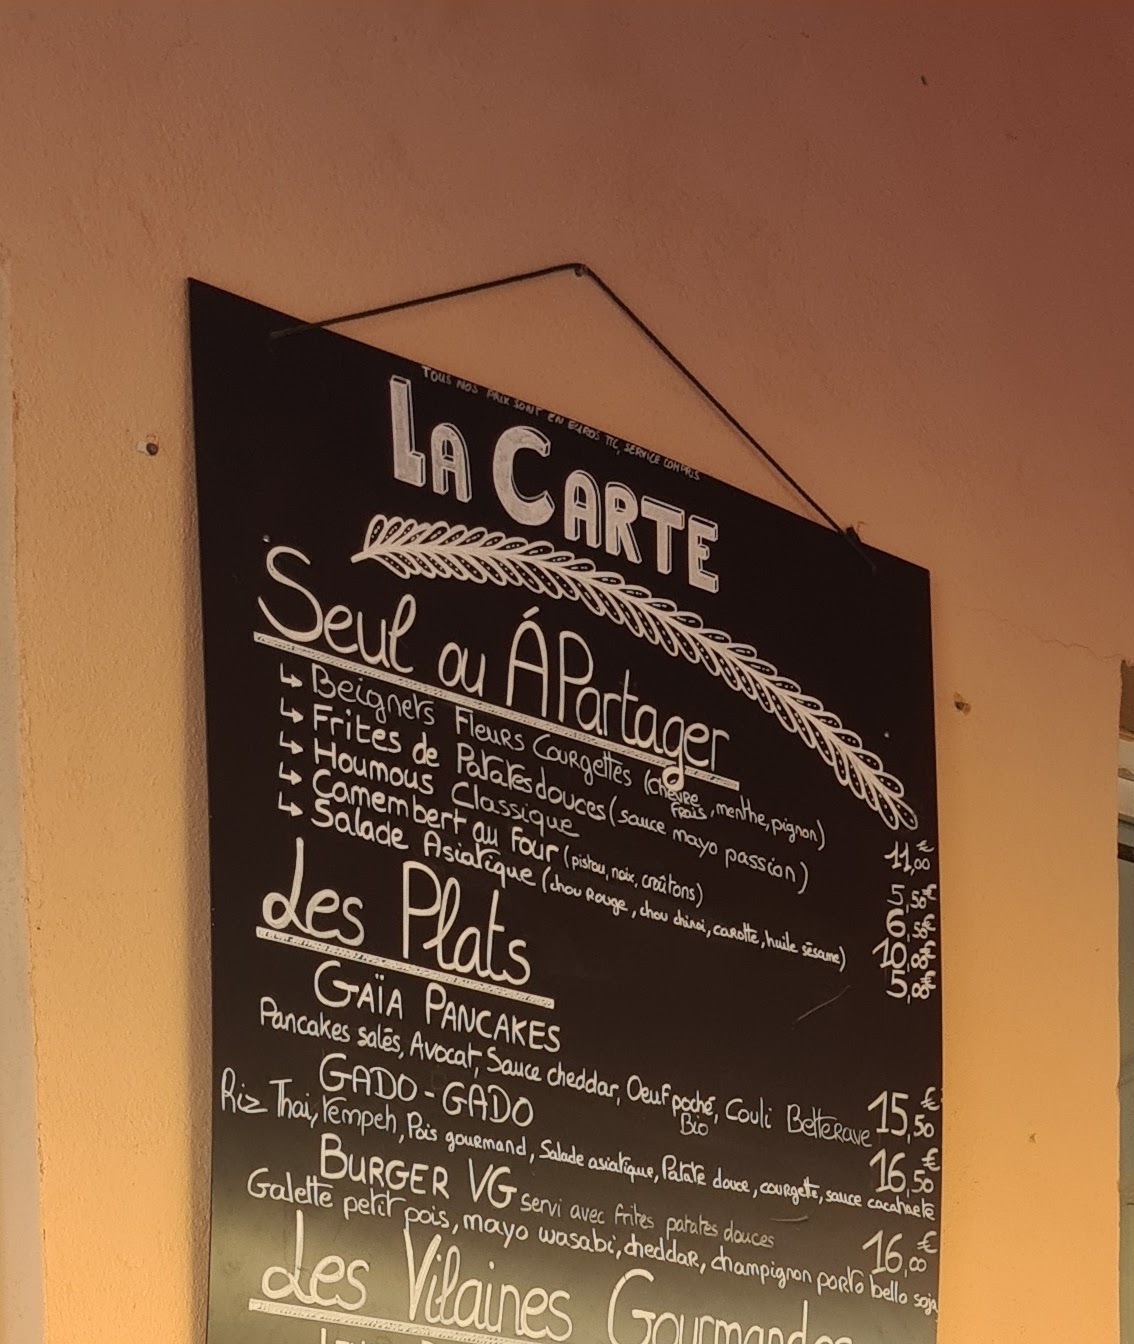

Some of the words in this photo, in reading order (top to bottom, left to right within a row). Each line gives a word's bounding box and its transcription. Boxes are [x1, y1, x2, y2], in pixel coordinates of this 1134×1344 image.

[257, 545, 417, 674] Seul
[437, 641, 486, 698] ou
[310, 797, 409, 850] Salade
[422, 829, 536, 889] Asiatique
[312, 767, 467, 835] Camembert
[472, 820, 499, 847] au
[313, 736, 434, 795] Houmous
[450, 780, 580, 838] Classique
[313, 703, 402, 754] Frites
[411, 731, 440, 768] de
[534, 765, 607, 821] douces
[671, 828, 718, 858] mayo
[724, 847, 809, 895] passion)
[261, 836, 365, 947] Les
[401, 859, 531, 986] Plats
[259, 995, 351, 1043] Pancakes
[485, 1045, 542, 1082] Sauce
[724, 1097, 772, 1129] Couli
[679, 1111, 709, 1137] Bio
[220, 1066, 268, 1114] Riz
[538, 1138, 585, 1167] Salade
[661, 1153, 707, 1186] Patate
[824, 1189, 863, 1208] sauce
[467, 1157, 518, 1209] VG
[569, 1203, 606, 1225] avec
[723, 1219, 775, 1249] douces
[246, 1166, 334, 1208] Galette
[343, 1187, 408, 1232] petit
[462, 1213, 529, 1249] mayo
[710, 1244, 812, 1290] champignon
[868, 1273, 908, 1305] bello
[260, 1208, 369, 1311] Les
[402, 1226, 573, 1342] Vilaines
